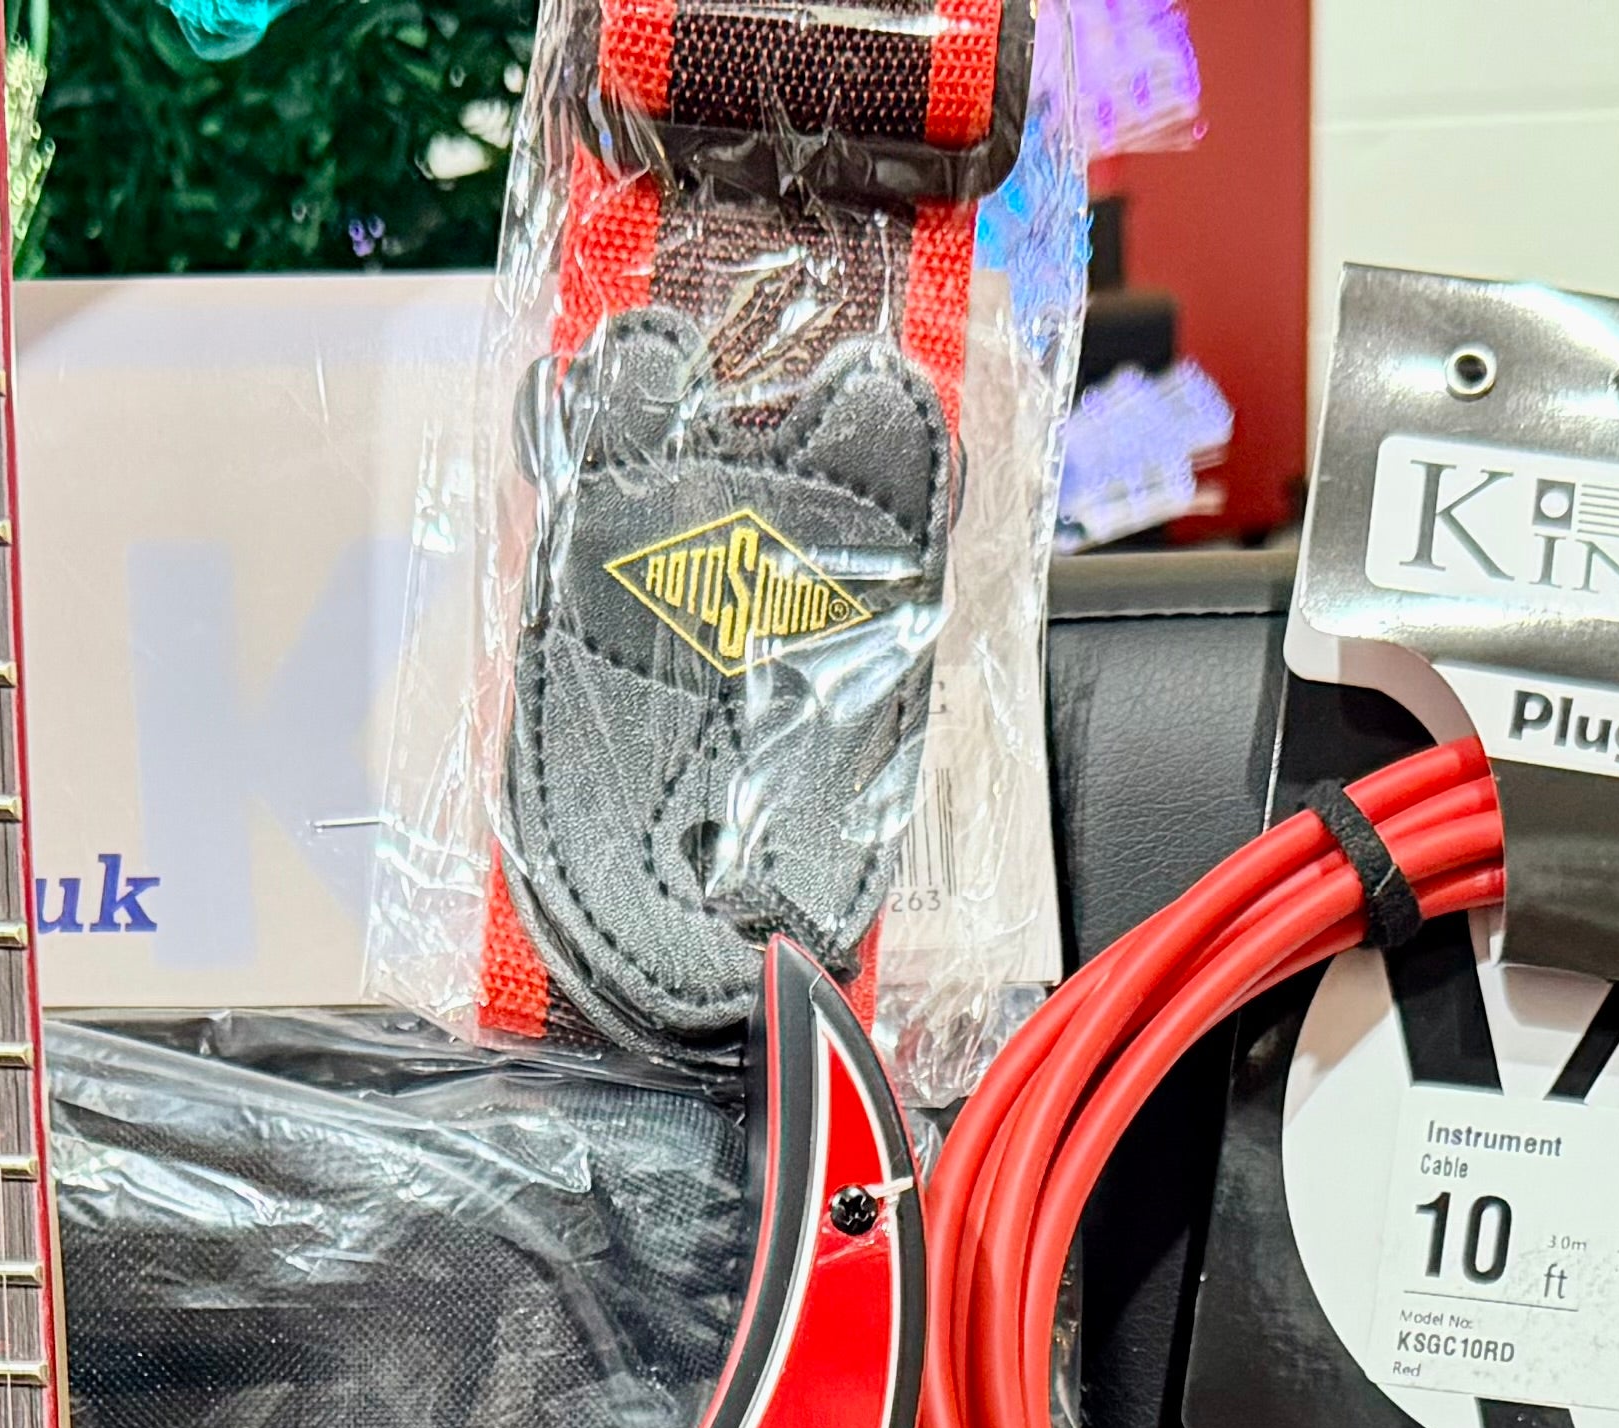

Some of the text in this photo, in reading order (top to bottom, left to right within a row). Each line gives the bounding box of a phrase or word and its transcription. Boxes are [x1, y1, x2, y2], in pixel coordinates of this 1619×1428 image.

[1427, 1120, 1562, 1157] Instrument
[1420, 1153, 1469, 1178] Cable
[1415, 1191, 1513, 1285] 10
[1543, 1263, 1568, 1299] ft
[1399, 1309, 1444, 1326] Model
[1396, 1331, 1515, 1363] KSGC10RD
[1392, 1361, 1422, 1377] Red
